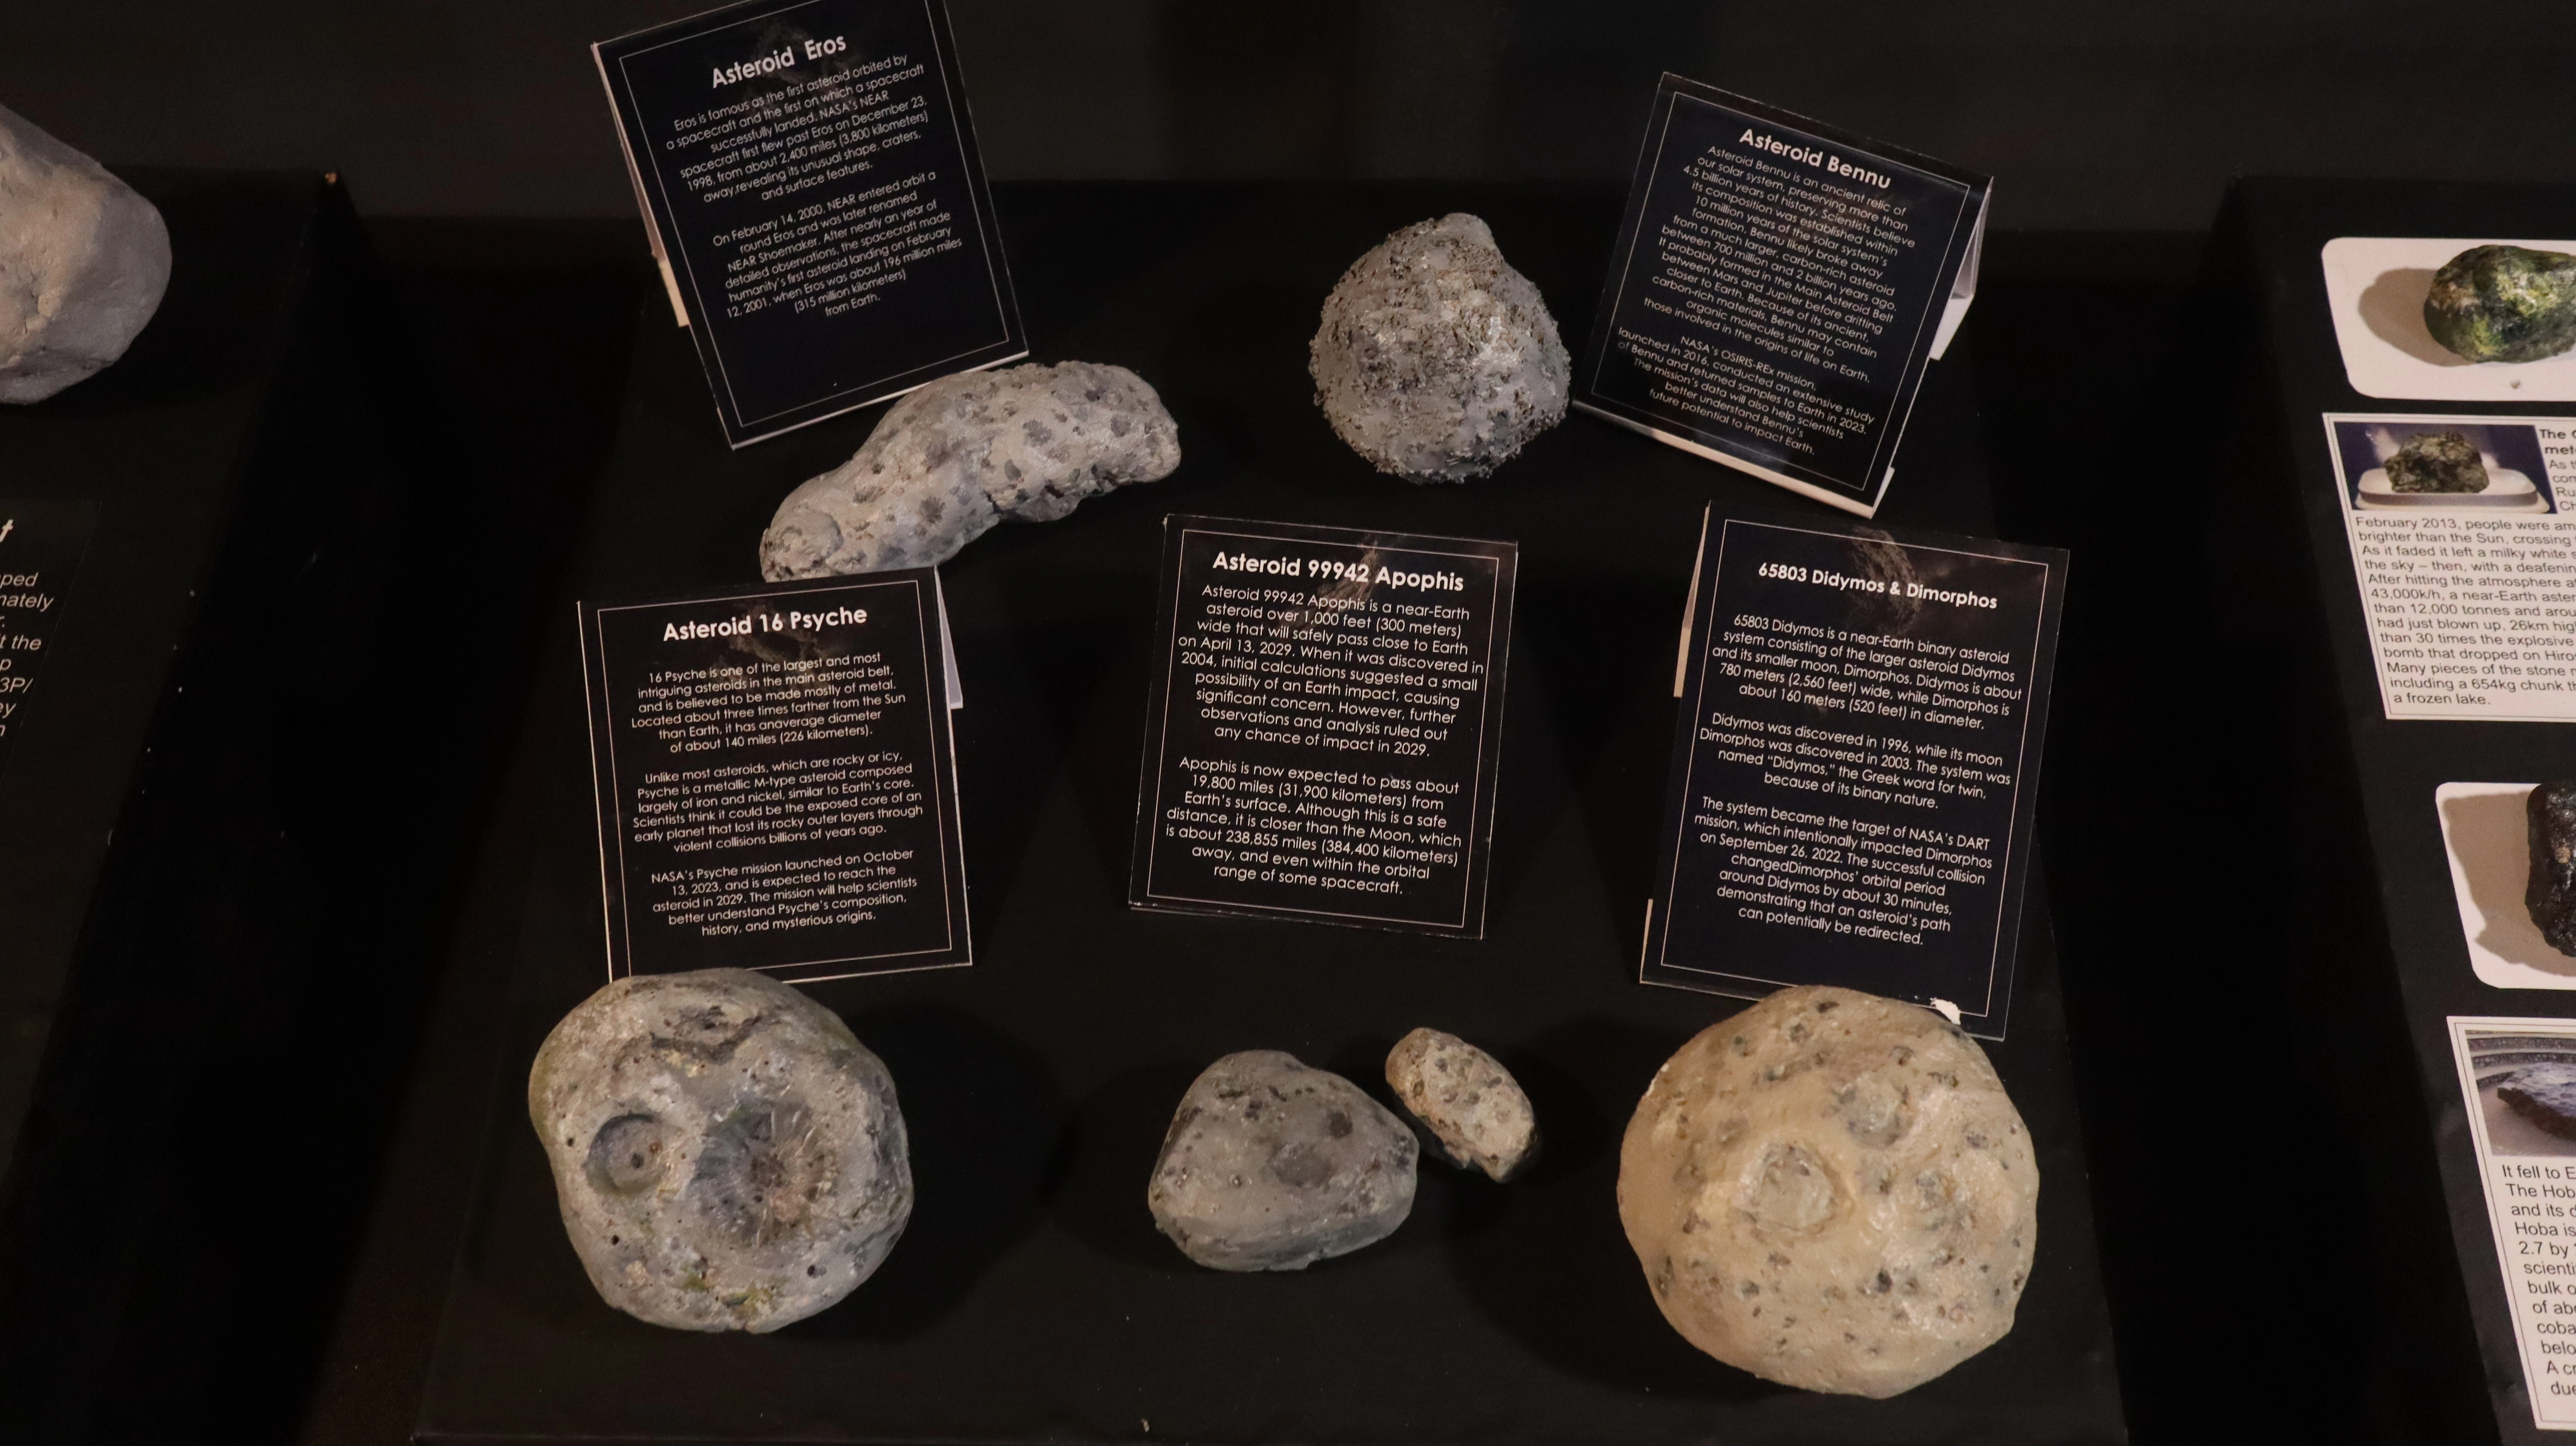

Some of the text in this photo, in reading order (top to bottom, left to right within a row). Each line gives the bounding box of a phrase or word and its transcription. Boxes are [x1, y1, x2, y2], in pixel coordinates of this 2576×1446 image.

[713, 36, 846, 89] Asteroid Eros
[710, 90, 889, 153] successfully landed. NASA's NEAR
[1739, 128, 1891, 189] Asteroid Bennu
[761, 161, 873, 200] and surface features.
[1683, 165, 1916, 248] 4.5 billion years of history. Scientists believe
[727, 255, 756, 273] NEAR
[823, 228, 848, 243] After
[850, 217, 882, 234] nearly
[884, 213, 899, 224] an
[900, 205, 924, 221] year
[926, 198, 937, 211] of
[1661, 251, 1883, 335] between Mars and Jupiter before drifting
[825, 293, 881, 317] from Earth.
[1721, 350, 1774, 376] OSIRIS-REx
[2540, 429, 2566, 439] The
[2545, 445, 2576, 454] met
[2549, 460, 2567, 469] As
[2556, 487, 2576, 497] Ru
[2355, 516, 2417, 530] February
[2421, 517, 2461, 530] 2013,
[2465, 519, 2512, 532] people
[2555, 523, 2576, 531] am
[2358, 531, 2571, 547] brighter than the Sun, crossing
[0, 572, 39, 589] ped
[1212, 551, 1464, 592] Asteroid 99942 Apophis
[1758, 562, 1997, 609] 65803 Didymos & Dimorphos
[2371, 588, 2445, 601] 43,000k/h,
[2462, 590, 2537, 601] near-Earth
[663, 606, 868, 642] Asteroid 16 Psyche
[1206, 603, 1461, 640] asteroid over 1,000 feet (300 meters)
[12, 635, 42, 651] the
[2380, 632, 2573, 647] than 30 times the explosive
[2390, 677, 2454, 692] including
[2459, 680, 2467, 689] a
[2471, 678, 2516, 693] 654kg
[2520, 680, 2564, 691] chunk
[1739, 684, 1984, 730] about 160 meters (520 feet) in diameter.
[2394, 692, 2491, 705] a frozen lake.
[631, 693, 906, 728] Located about three times farther from the Sun
[659, 729, 686, 740] than
[689, 724, 722, 737] Earth,
[725, 723, 732, 733] it
[735, 723, 756, 732] has
[828, 710, 881, 724] diameter
[1185, 790, 1447, 828] Earth's surface. Although this is a safe
[1214, 866, 1403, 894] range of some spacecraft.
[1862, 874, 1902, 890] orbital
[1904, 881, 1946, 896] period
[702, 910, 876, 936] history, and mysterious origins.
[1738, 907, 1923, 945] can potentially be redirected.
[2502, 1164, 2513, 1178] It
[2517, 1165, 2540, 1179] fell
[2545, 1166, 2560, 1179] to
[2505, 1183, 2576, 1198] The Hob
[2511, 1203, 2564, 1217] and its
[2515, 1221, 2576, 1236] Hoba is
[2519, 1241, 2543, 1255] 2.7
[2549, 1242, 2568, 1259] by
[2527, 1280, 2562, 1294] bulk
[2533, 1300, 2576, 1315] of ab
[2541, 1340, 2576, 1355] belo
[2547, 1360, 2559, 1374] A
